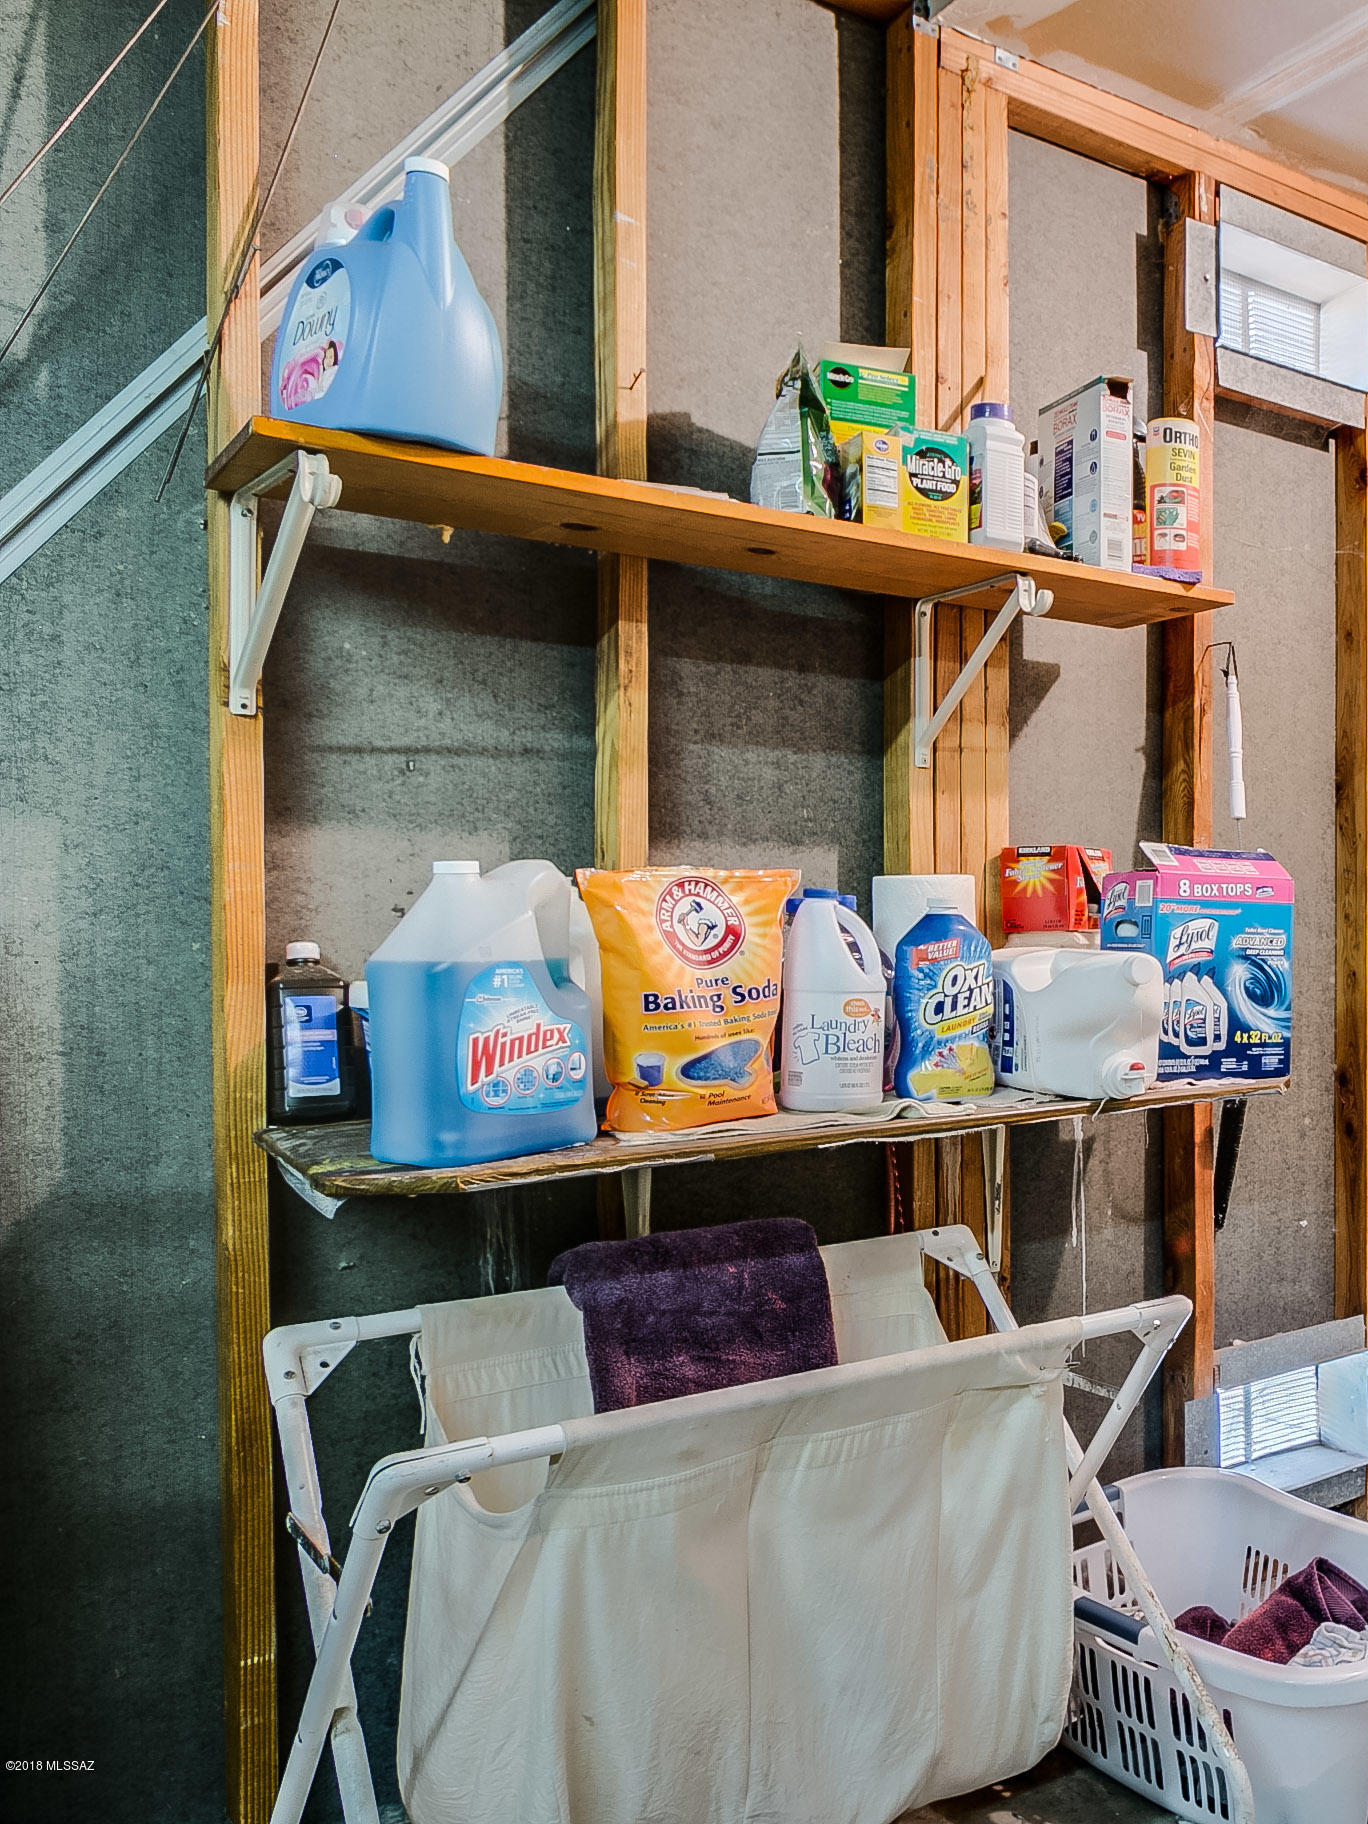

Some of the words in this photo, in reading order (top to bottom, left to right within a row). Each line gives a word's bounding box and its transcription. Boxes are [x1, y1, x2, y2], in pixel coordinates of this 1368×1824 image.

[293, 306, 338, 347] Downy
[1053, 414, 1078, 436] BORAX
[1163, 426, 1199, 450] ORTHO
[1171, 447, 1196, 460] SEVIN
[906, 454, 962, 481] Miracle-Gro
[911, 478, 937, 491] PLANT
[937, 482, 957, 494] FOOD
[1107, 886, 1127, 910] Lysol
[1178, 879, 1190, 897] 8
[1193, 884, 1220, 897] BOX
[1221, 883, 1252, 897] TOPS
[662, 896, 675, 932] ARM
[671, 885, 683, 901] &
[683, 881, 739, 926] HAMMER
[928, 940, 958, 952] BETTER
[1173, 921, 1215, 953] Lysol
[1235, 935, 1285, 946] ADVANCED
[492, 974, 509, 988] #1
[696, 976, 730, 990] Pure
[943, 962, 985, 997] OXI
[643, 989, 724, 1014] Baking
[732, 977, 778, 1005] Soda
[924, 981, 994, 1026] CLEAN
[643, 1021, 685, 1032] America's
[723, 1015, 751, 1026] Baking
[752, 1012, 767, 1020] Soda
[810, 1014, 869, 1034] Laundry
[941, 1016, 977, 1033] LAUNDRY
[823, 1032, 880, 1055] Bleach
[1234, 1030, 1241, 1043] 4
[1249, 1030, 1261, 1043] 32
[470, 1022, 570, 1087] Windex
[707, 1090, 725, 1100] Pool
[707, 1094, 752, 1107] Maintenance
